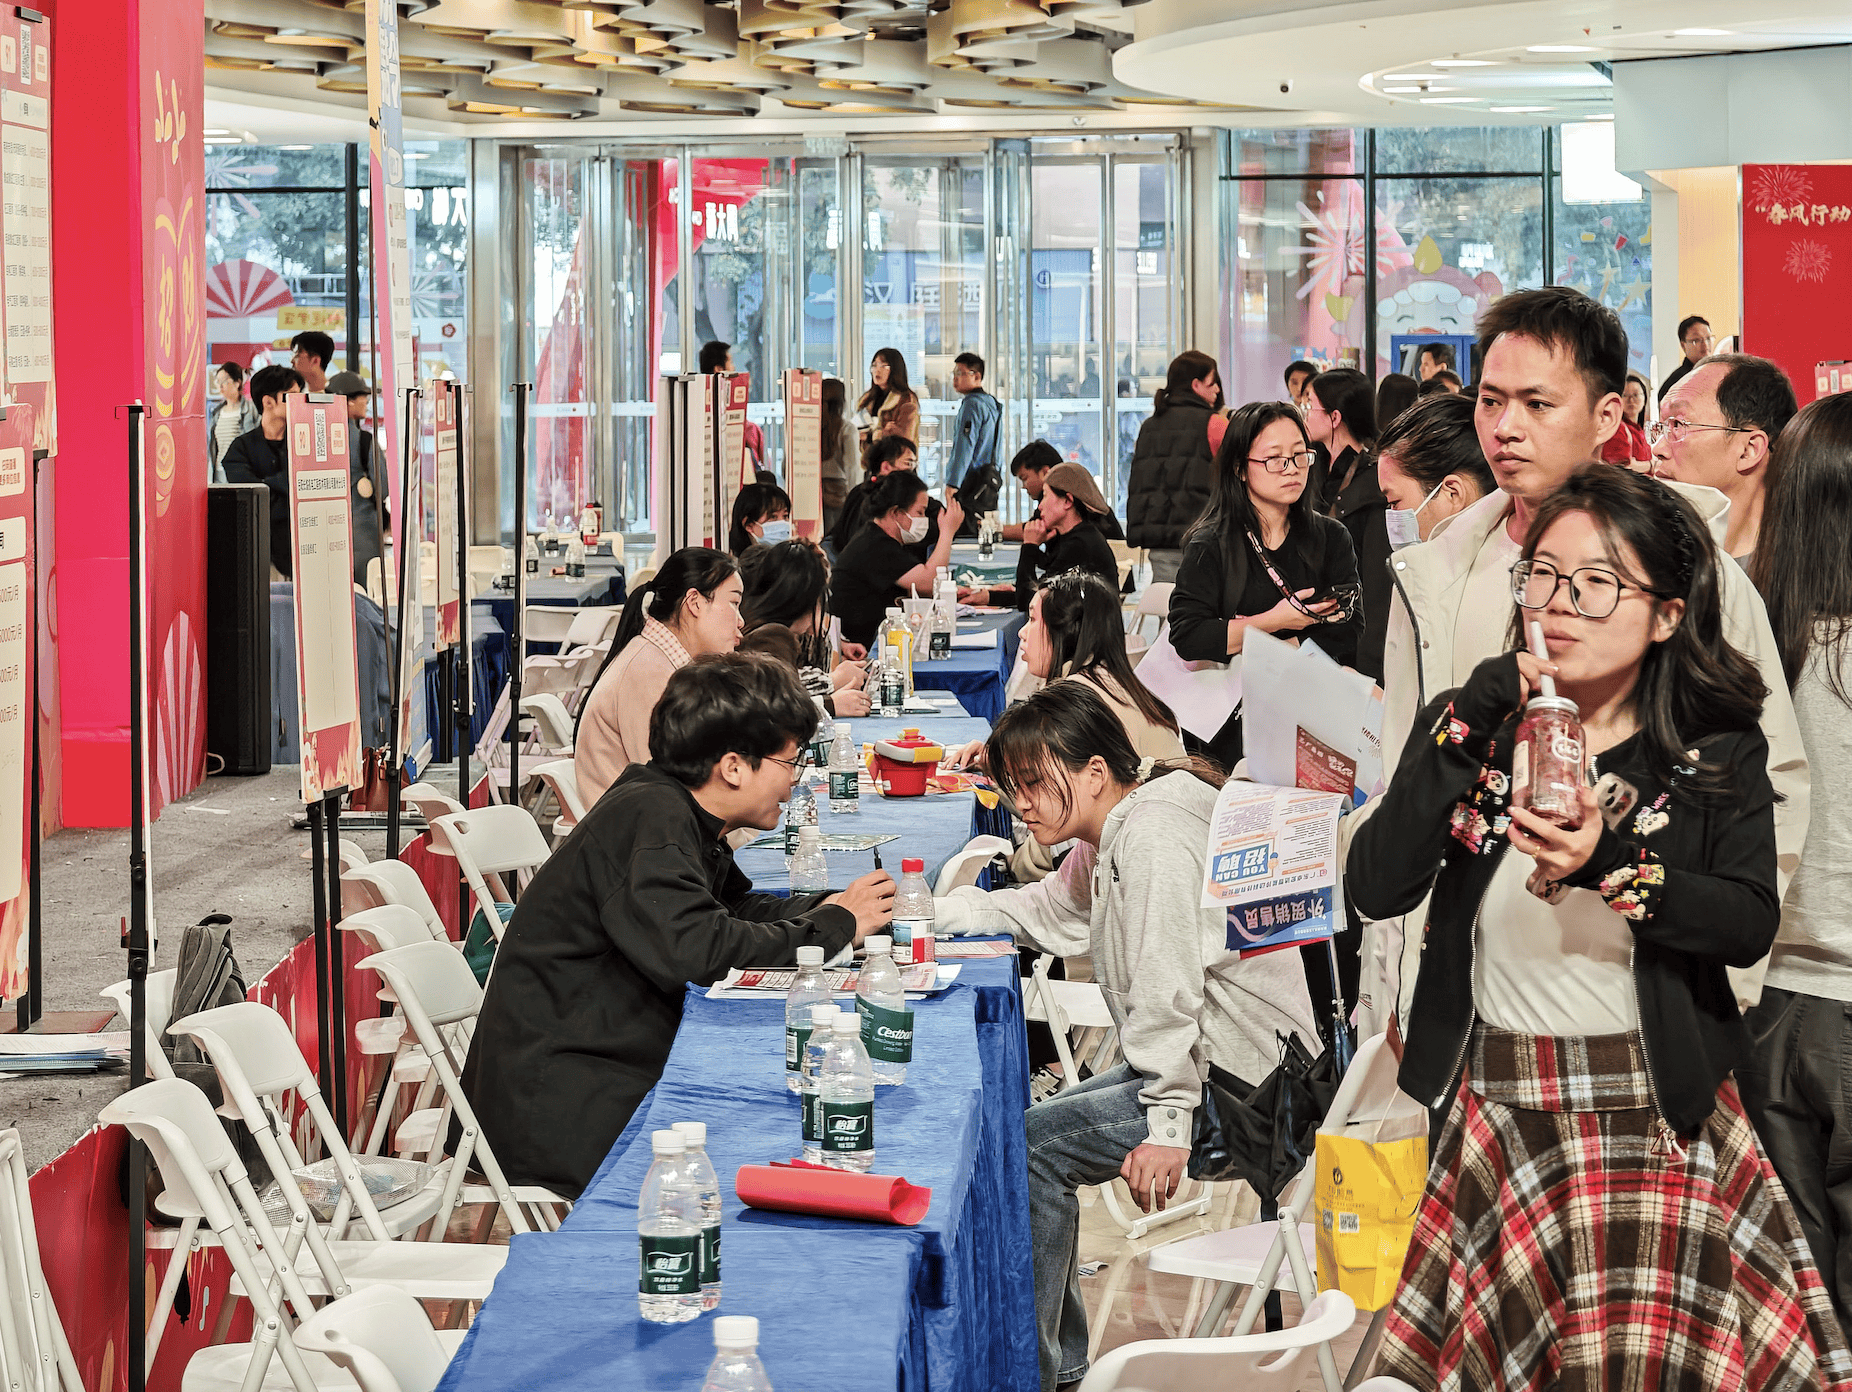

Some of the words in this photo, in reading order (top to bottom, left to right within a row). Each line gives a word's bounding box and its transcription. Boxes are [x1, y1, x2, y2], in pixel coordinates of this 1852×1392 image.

[1217, 846, 1268, 873] 招聘
[1215, 868, 1239, 882] CAN
[1243, 864, 1266, 880] YOU
[1244, 897, 1326, 930] 外贸销售员
